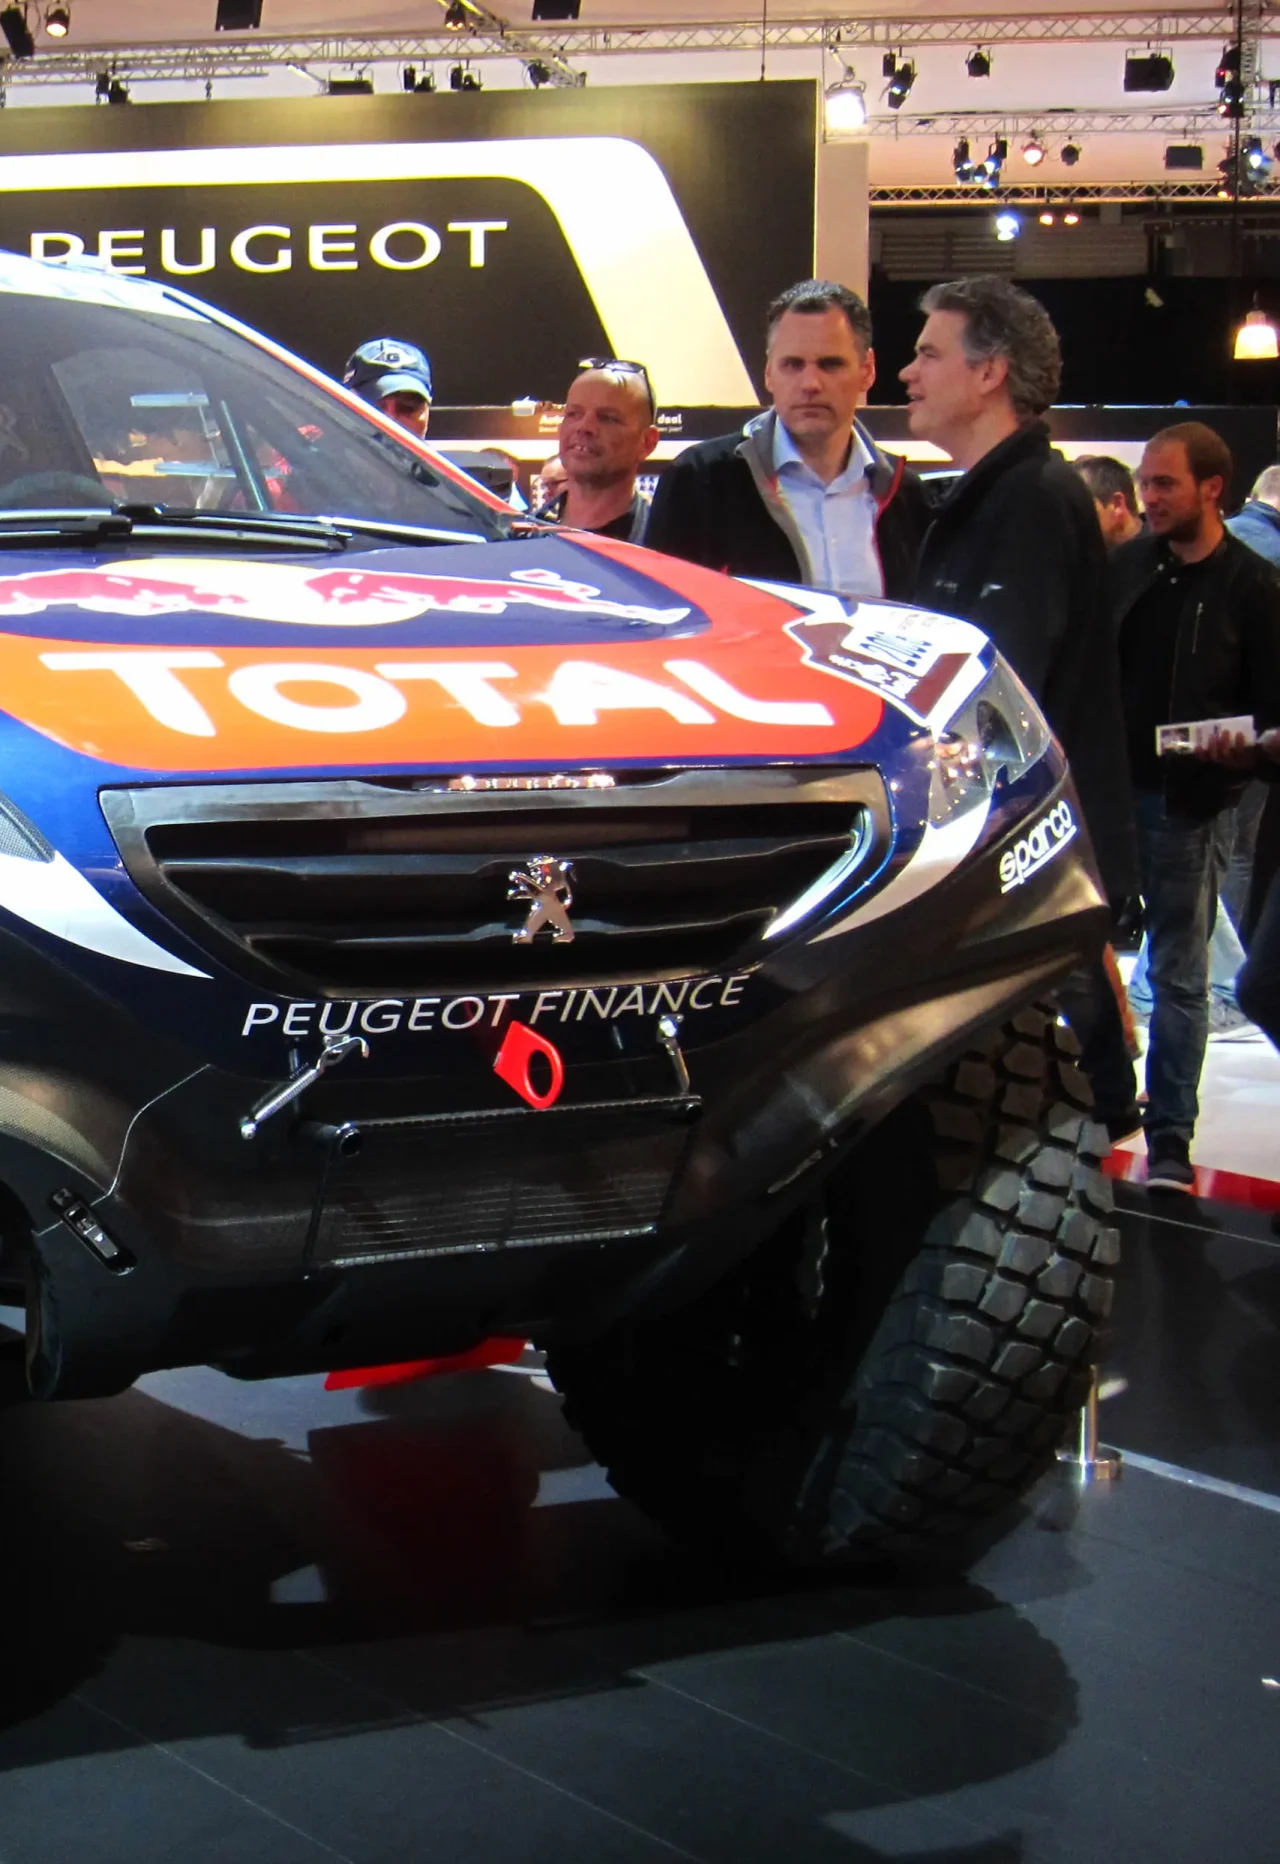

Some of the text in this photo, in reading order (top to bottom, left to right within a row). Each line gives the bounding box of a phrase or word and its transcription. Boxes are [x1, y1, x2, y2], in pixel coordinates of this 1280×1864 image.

[29, 220, 508, 276] PEUGEOT
[39, 650, 836, 738] TOTAL
[999, 800, 1073, 886] sparco
[241, 974, 750, 1037] PEUGEOT FINANCE
